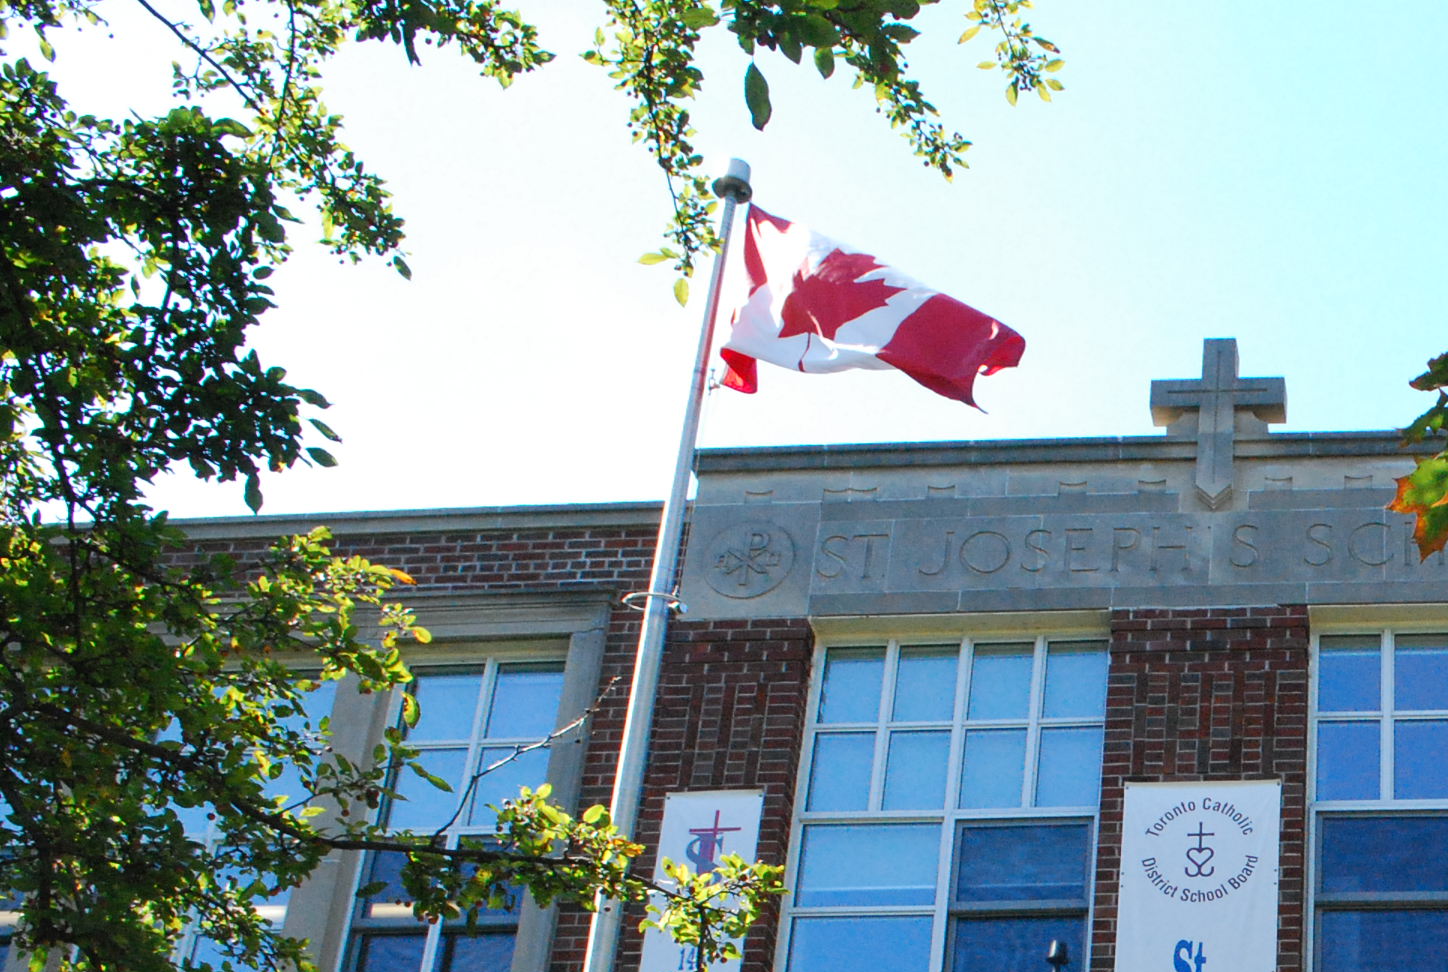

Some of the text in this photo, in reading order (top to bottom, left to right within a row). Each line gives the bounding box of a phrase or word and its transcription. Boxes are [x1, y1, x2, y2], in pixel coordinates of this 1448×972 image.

[918, 524, 1258, 575] JOSEPH'S
[1145, 797, 1254, 837] Toronto Catholic
[1142, 854, 1259, 902] District School Board
